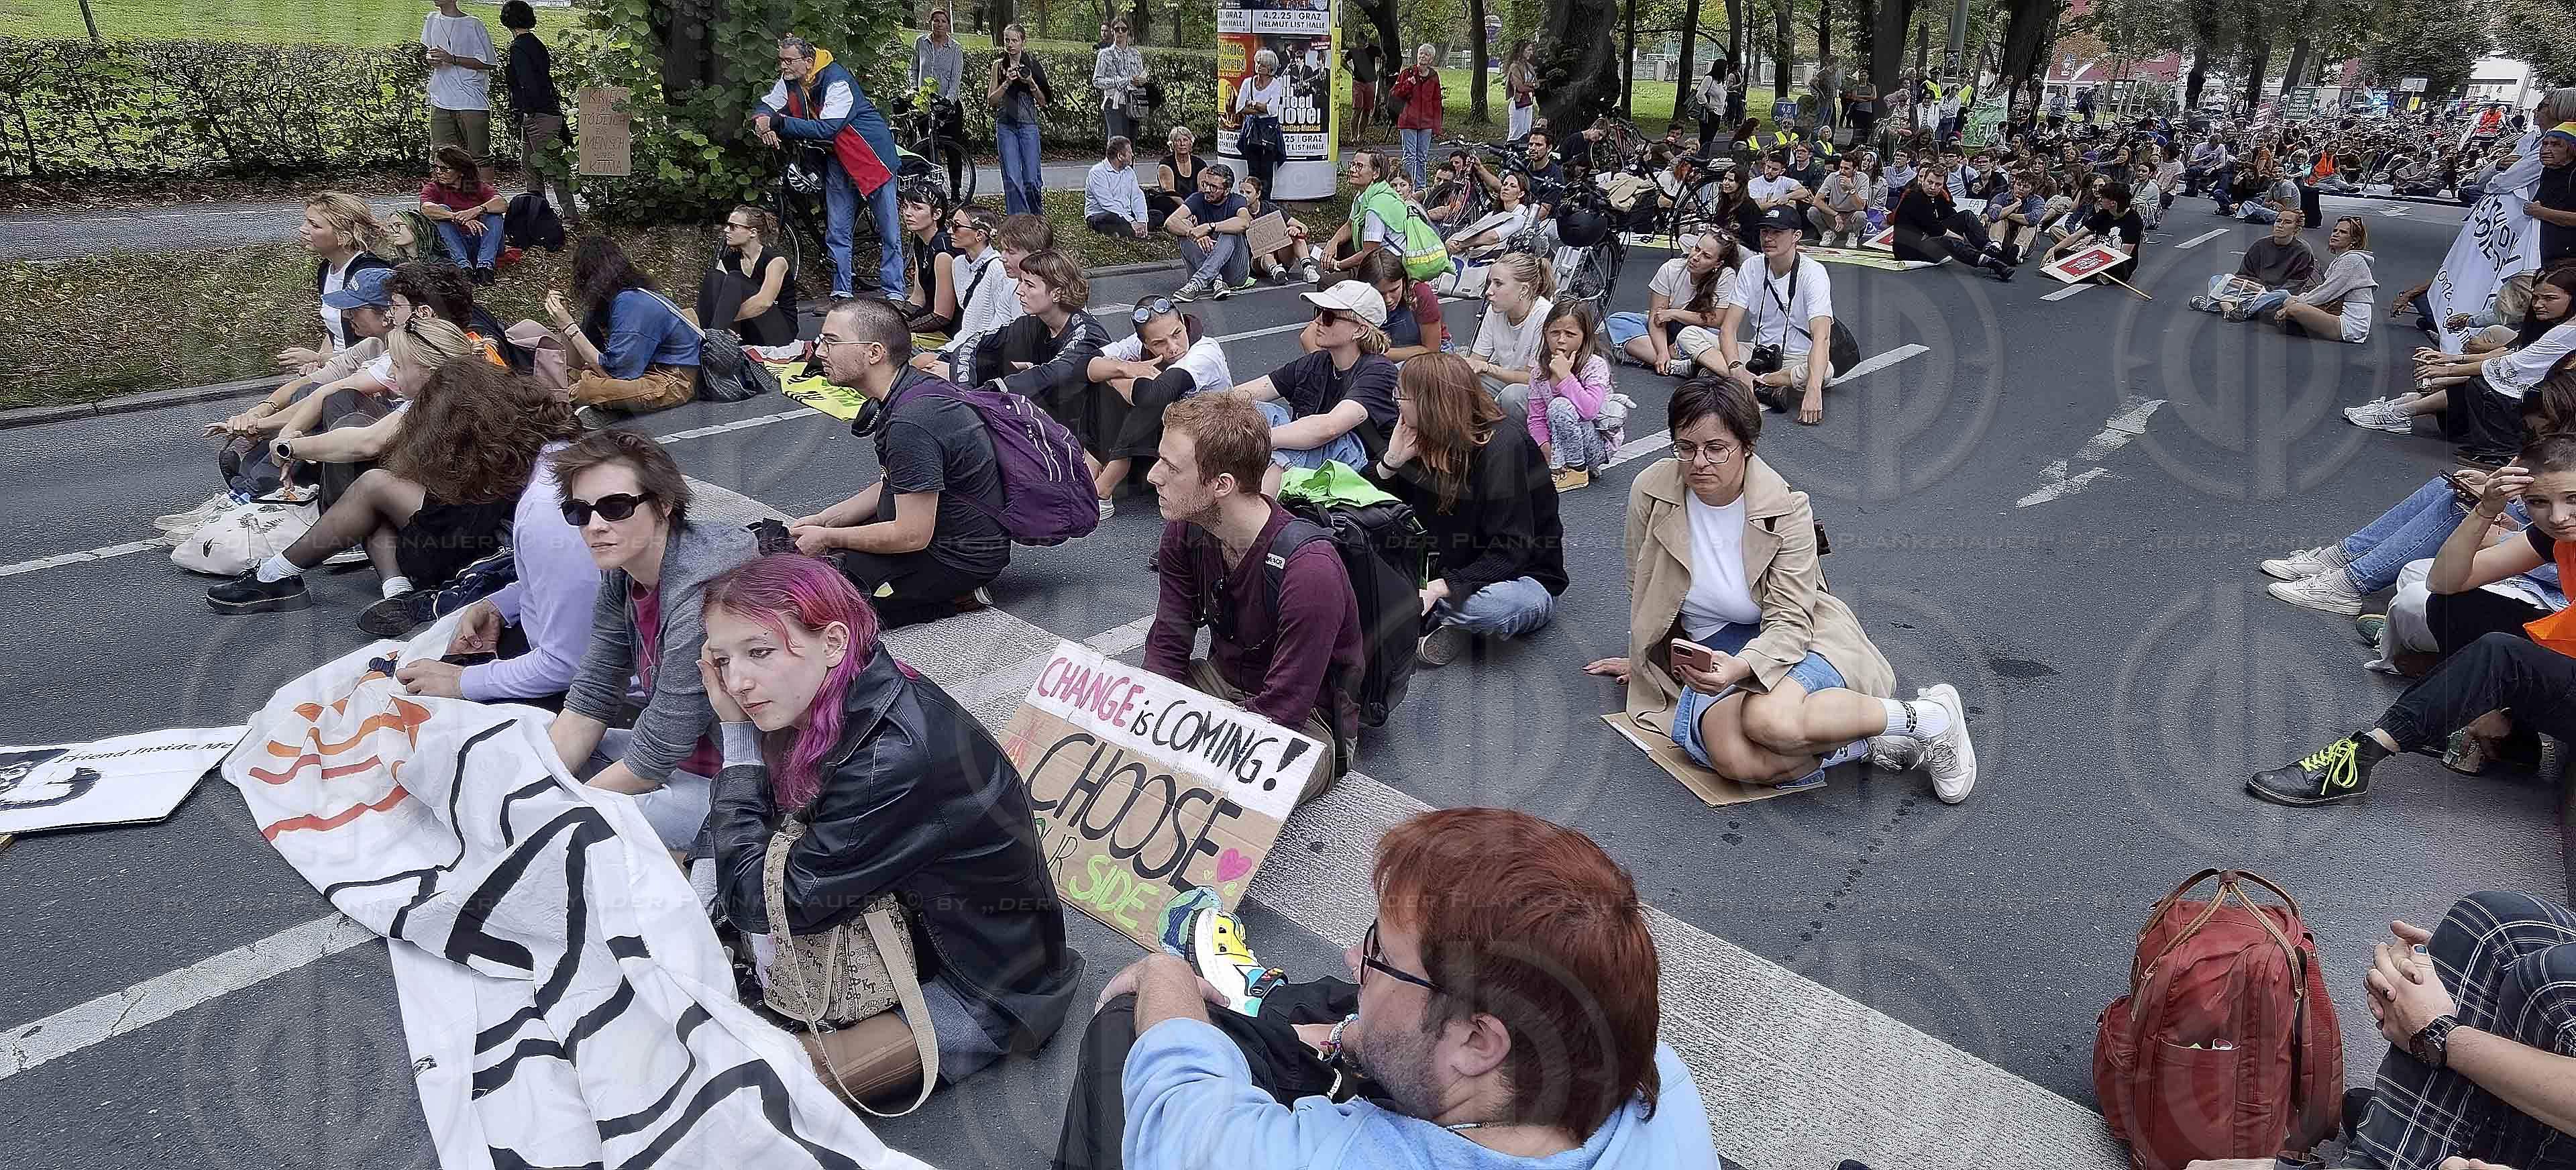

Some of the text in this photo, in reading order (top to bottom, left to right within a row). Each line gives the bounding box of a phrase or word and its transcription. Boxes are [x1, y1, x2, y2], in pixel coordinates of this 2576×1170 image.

[1263, 11, 1322, 21] 4.2.25 GRAZ
[588, 90, 623, 103] KRIEG
[1282, 93, 1313, 109] need
[584, 137, 625, 150] MENSCH
[589, 160, 622, 173] KLIMA
[1036, 657, 1311, 792] CHANGE is COMING!
[53, 741, 236, 764] Friend Inside Me
[1026, 733, 1243, 891] CHOOSE
[1068, 853, 1160, 929] SIDE
